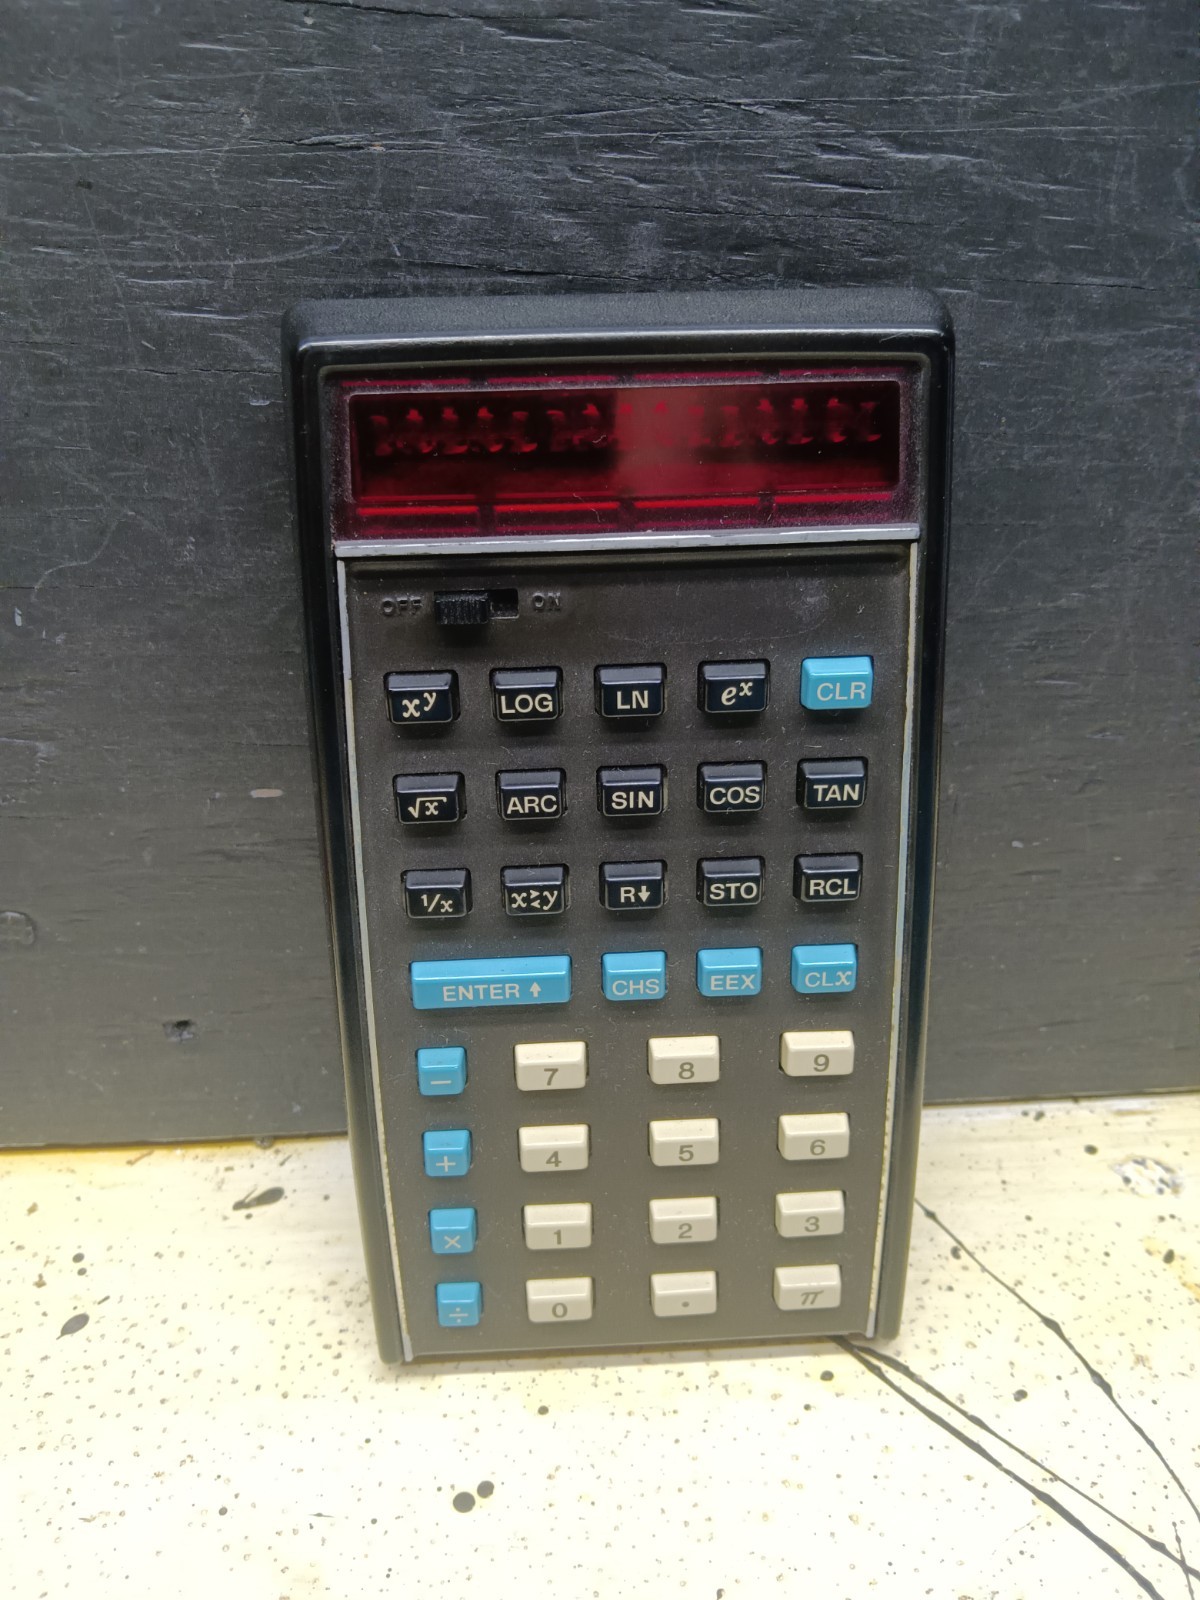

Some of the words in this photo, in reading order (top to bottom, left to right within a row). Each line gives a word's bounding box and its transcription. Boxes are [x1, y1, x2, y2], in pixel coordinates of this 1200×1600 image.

[381, 597, 422, 617] OFF
[532, 592, 562, 611] ON
[616, 689, 649, 710] LN
[816, 681, 867, 701] CLR
[501, 694, 554, 715] LOG
[611, 791, 654, 810] SIN
[709, 786, 761, 806] COS
[813, 783, 860, 803] TAN
[506, 794, 558, 814] ARC
[709, 882, 758, 901] STO
[809, 878, 856, 897] RCL
[442, 982, 521, 1002] ENTER
[612, 977, 661, 997] CHS
[710, 973, 756, 992] EEX
[678, 1062, 695, 1080] 8
[813, 1054, 830, 1072] 9
[543, 1067, 560, 1087] 7
[678, 1144, 695, 1162] 5
[810, 1139, 827, 1156] 6
[545, 1150, 563, 1168] 4
[678, 1222, 694, 1240] 2
[804, 1216, 821, 1233] 3
[553, 1229, 564, 1246] 1
[800, 1290, 823, 1306] π
[551, 1303, 568, 1318] 0
